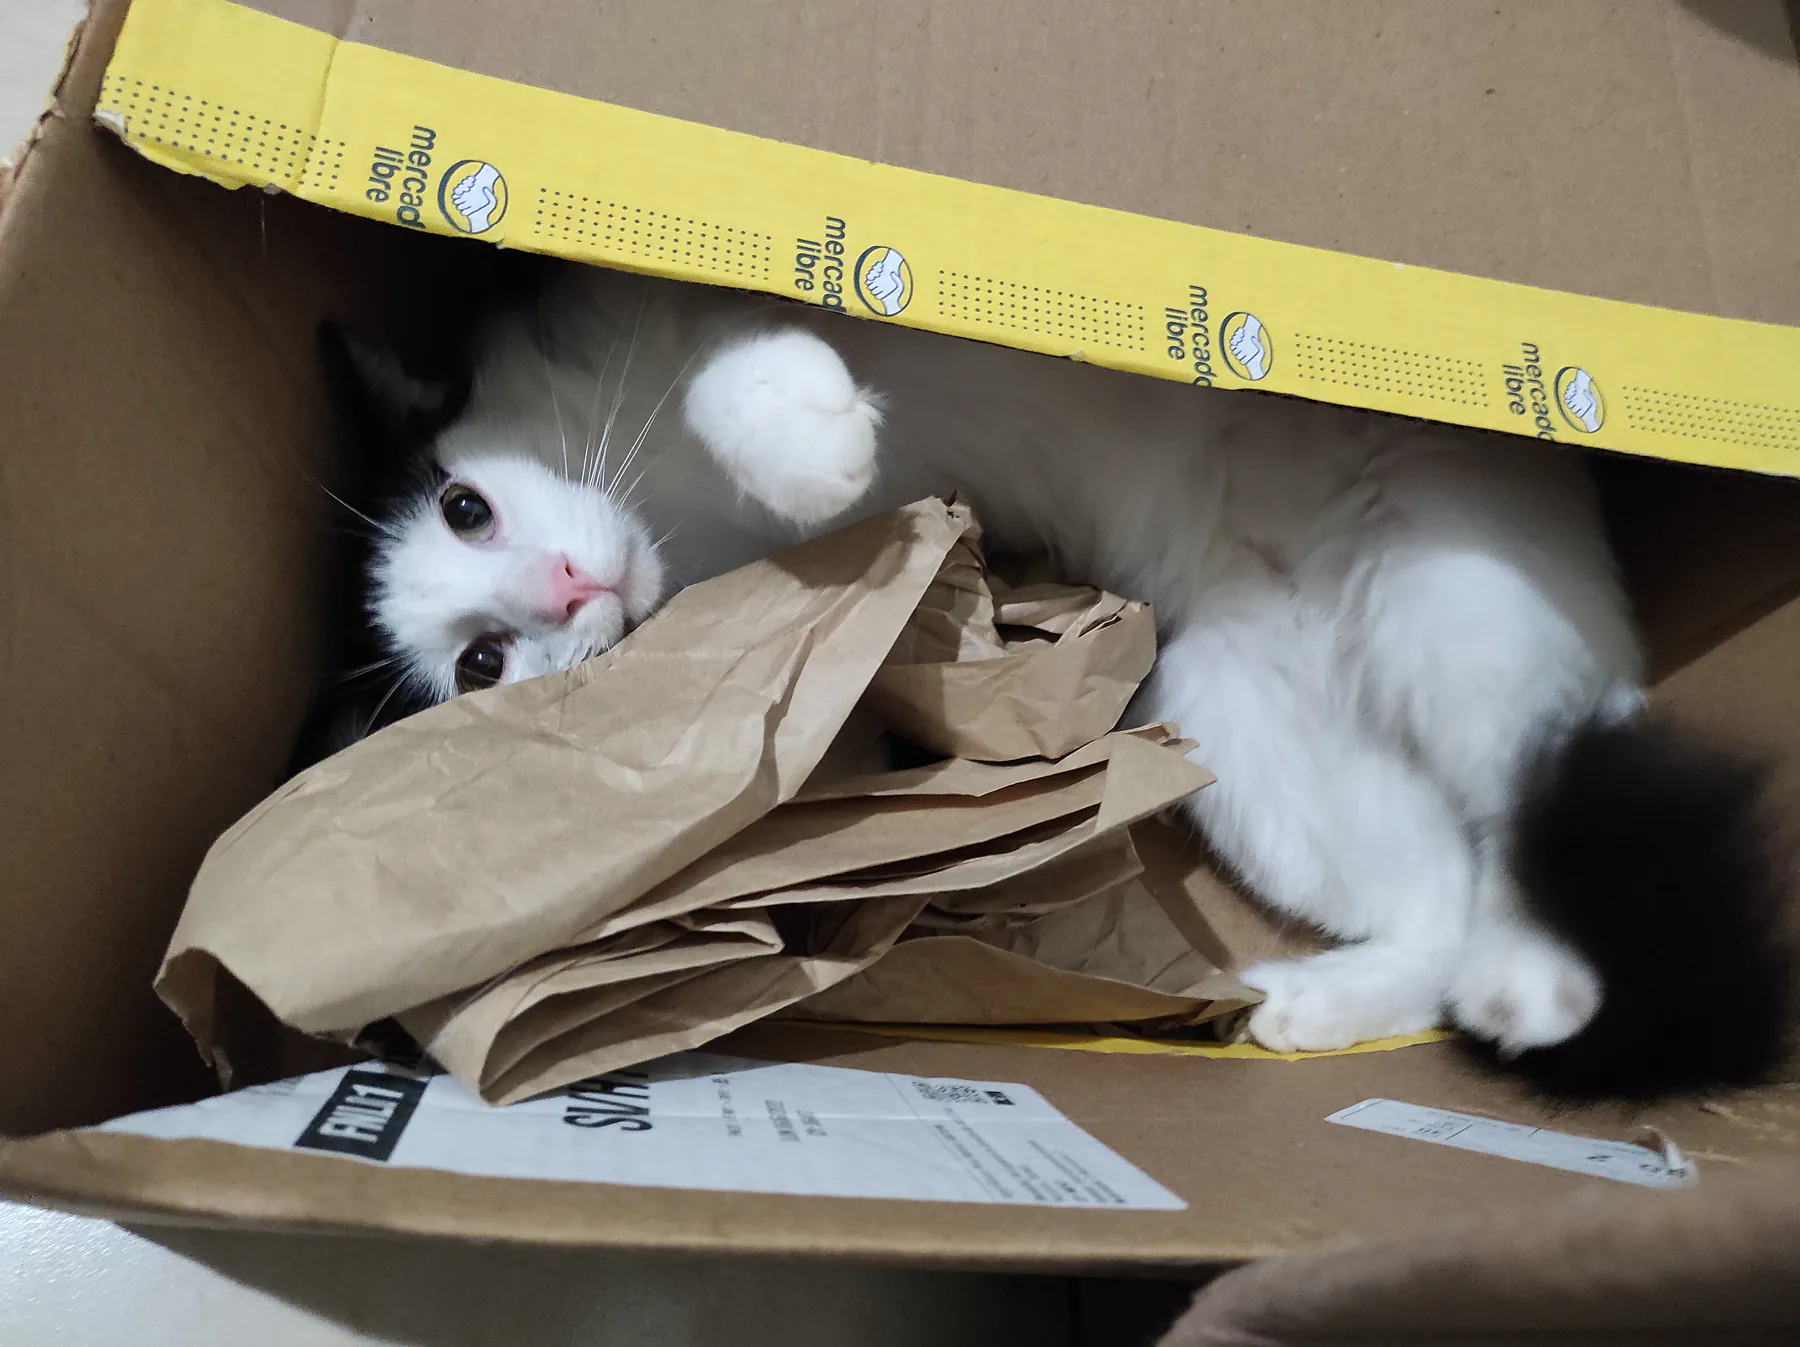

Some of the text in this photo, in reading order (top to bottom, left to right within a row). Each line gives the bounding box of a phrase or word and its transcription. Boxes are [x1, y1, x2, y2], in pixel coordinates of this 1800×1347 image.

[365, 146, 405, 203] libre
[794, 238, 822, 291] libre
[1164, 307, 1188, 360] libre
[1502, 364, 1526, 415] libre
